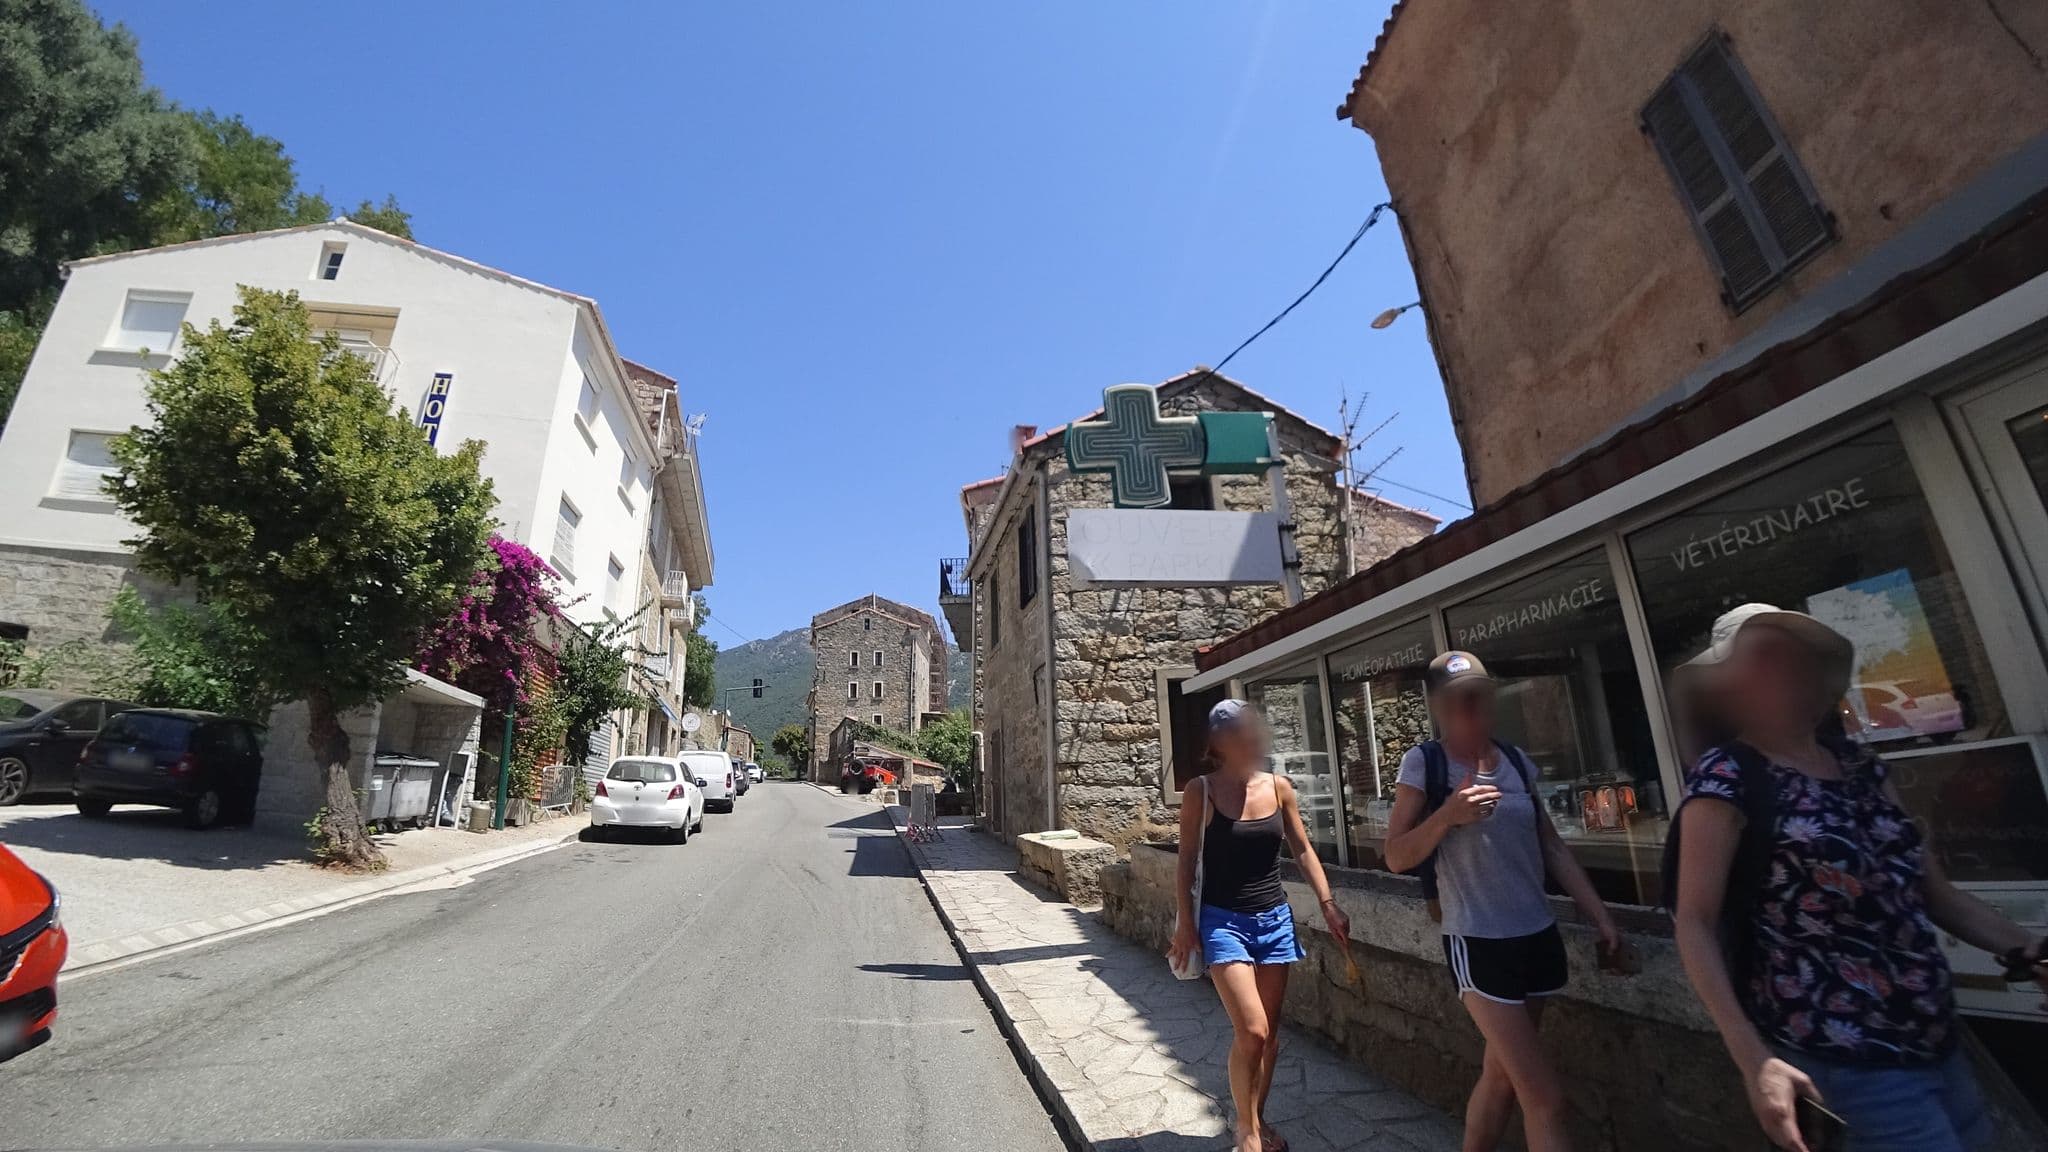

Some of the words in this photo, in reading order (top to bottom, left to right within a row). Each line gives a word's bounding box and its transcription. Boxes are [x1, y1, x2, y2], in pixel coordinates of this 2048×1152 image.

[1670, 476, 1870, 572] VÉTÉRINAIRE
[1457, 577, 1606, 647] PARAPHARMACIE
[1340, 642, 1426, 682] HOMÉOPATHIE
